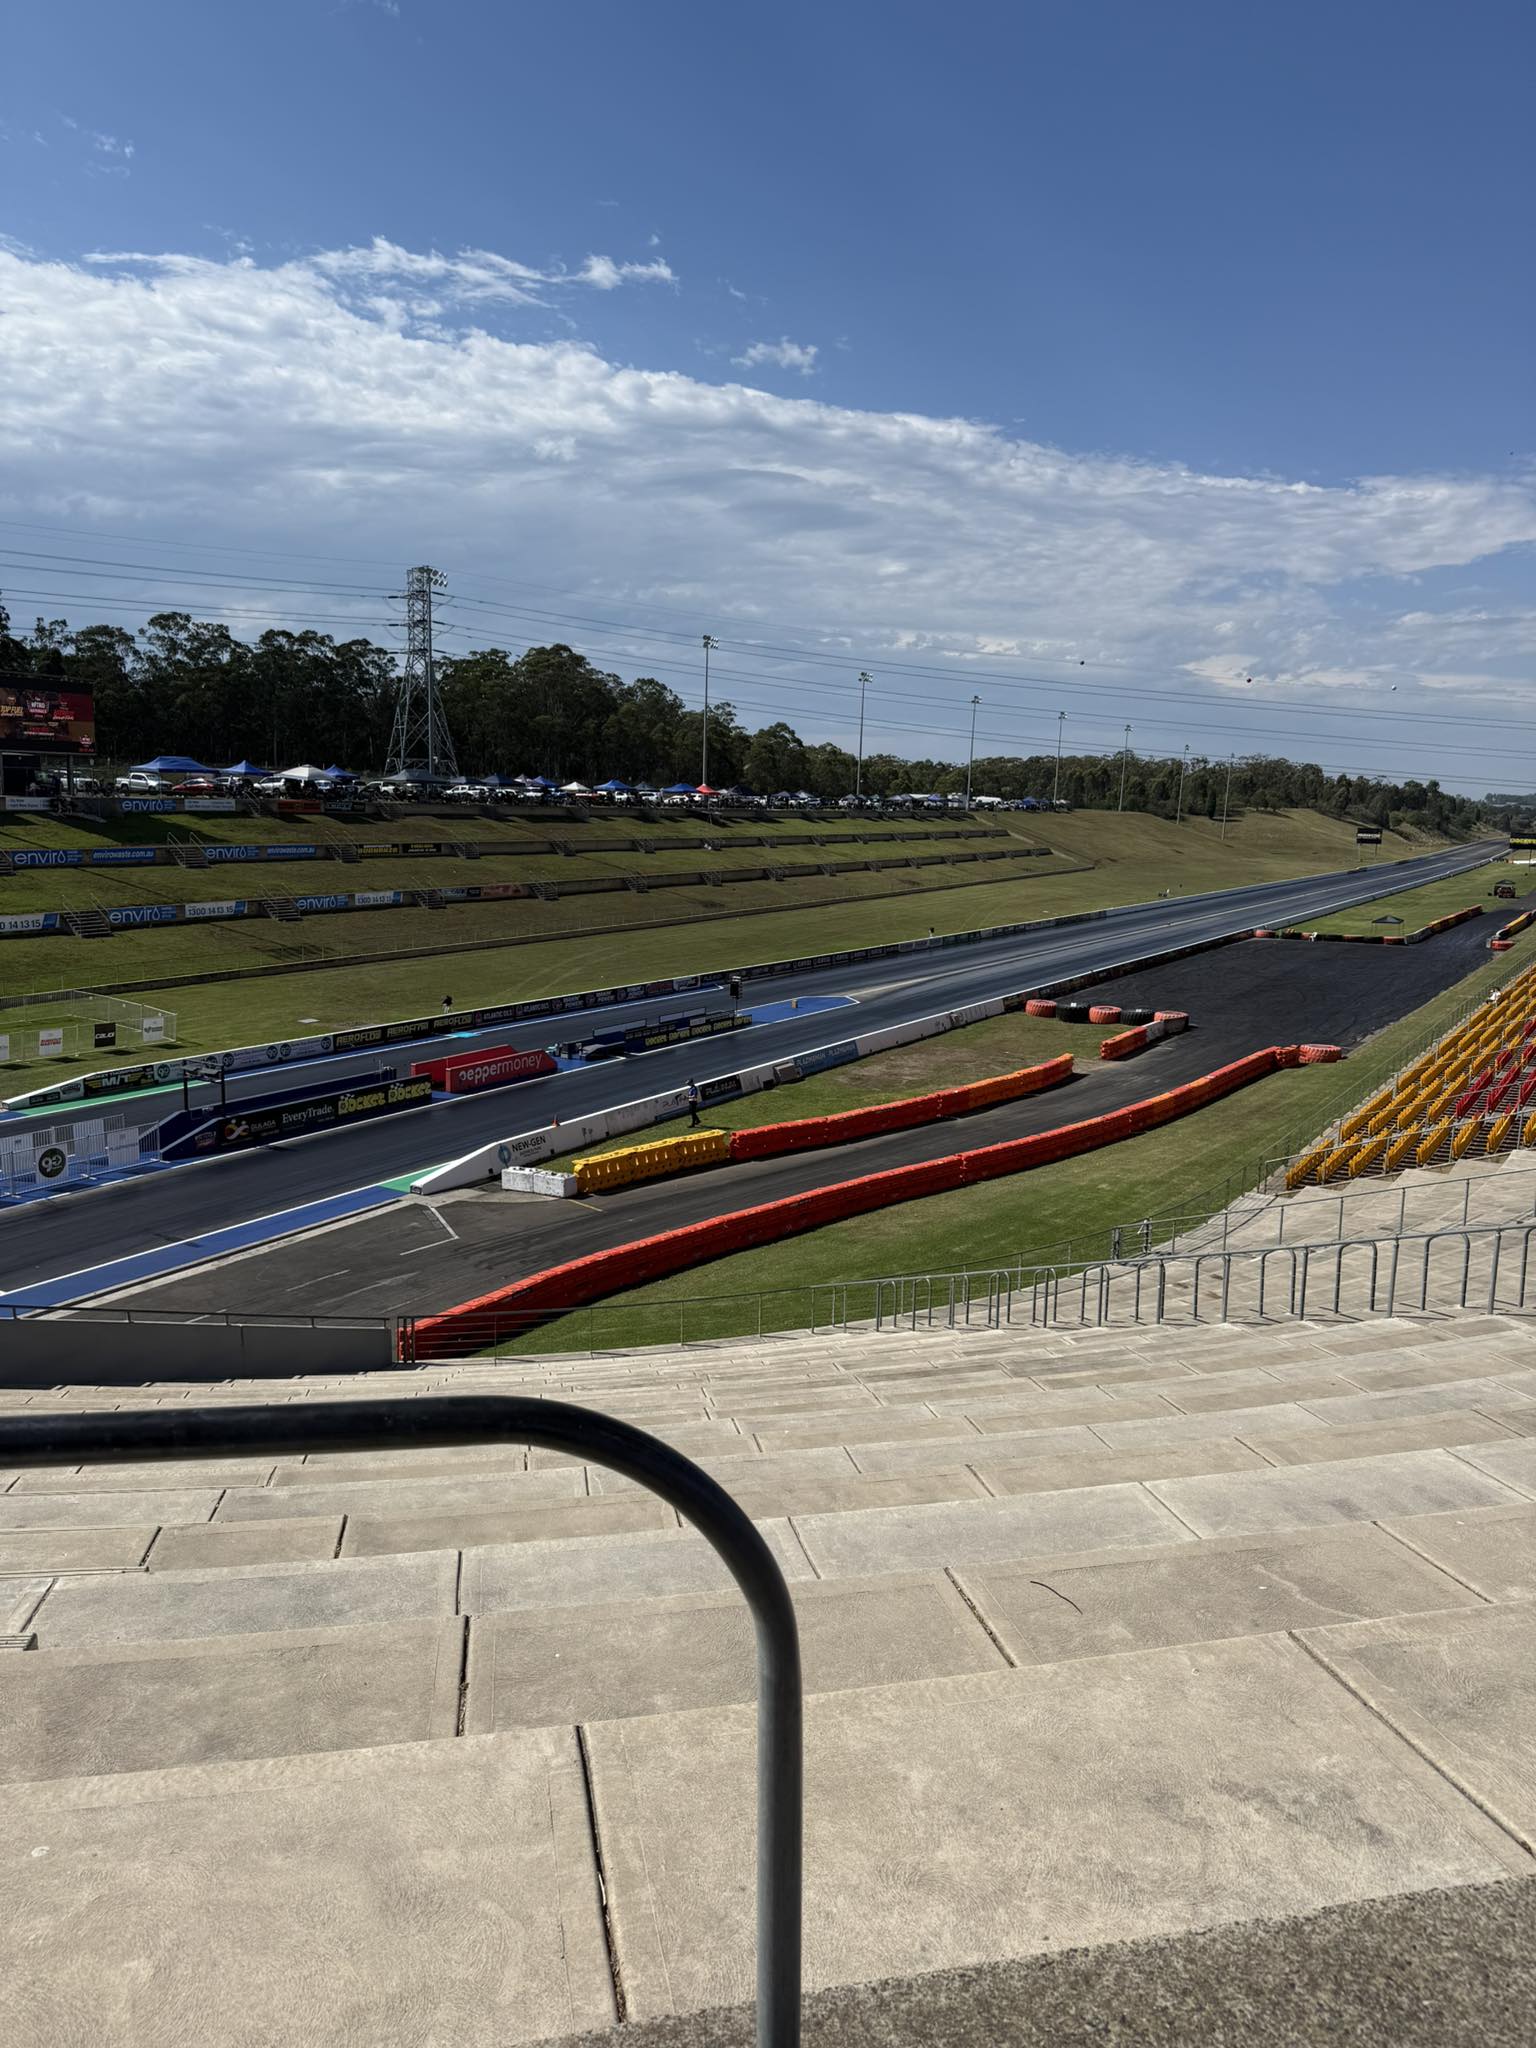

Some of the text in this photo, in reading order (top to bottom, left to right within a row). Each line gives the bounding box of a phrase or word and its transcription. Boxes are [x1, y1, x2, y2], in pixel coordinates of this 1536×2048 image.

[188, 905, 234, 916] 1300 14 13 15
[9, 921, 18, 929] 14
[20, 920, 29, 928] 13
[31, 919, 41, 928] 15
[511, 1135, 547, 1152] NEW-GEN
